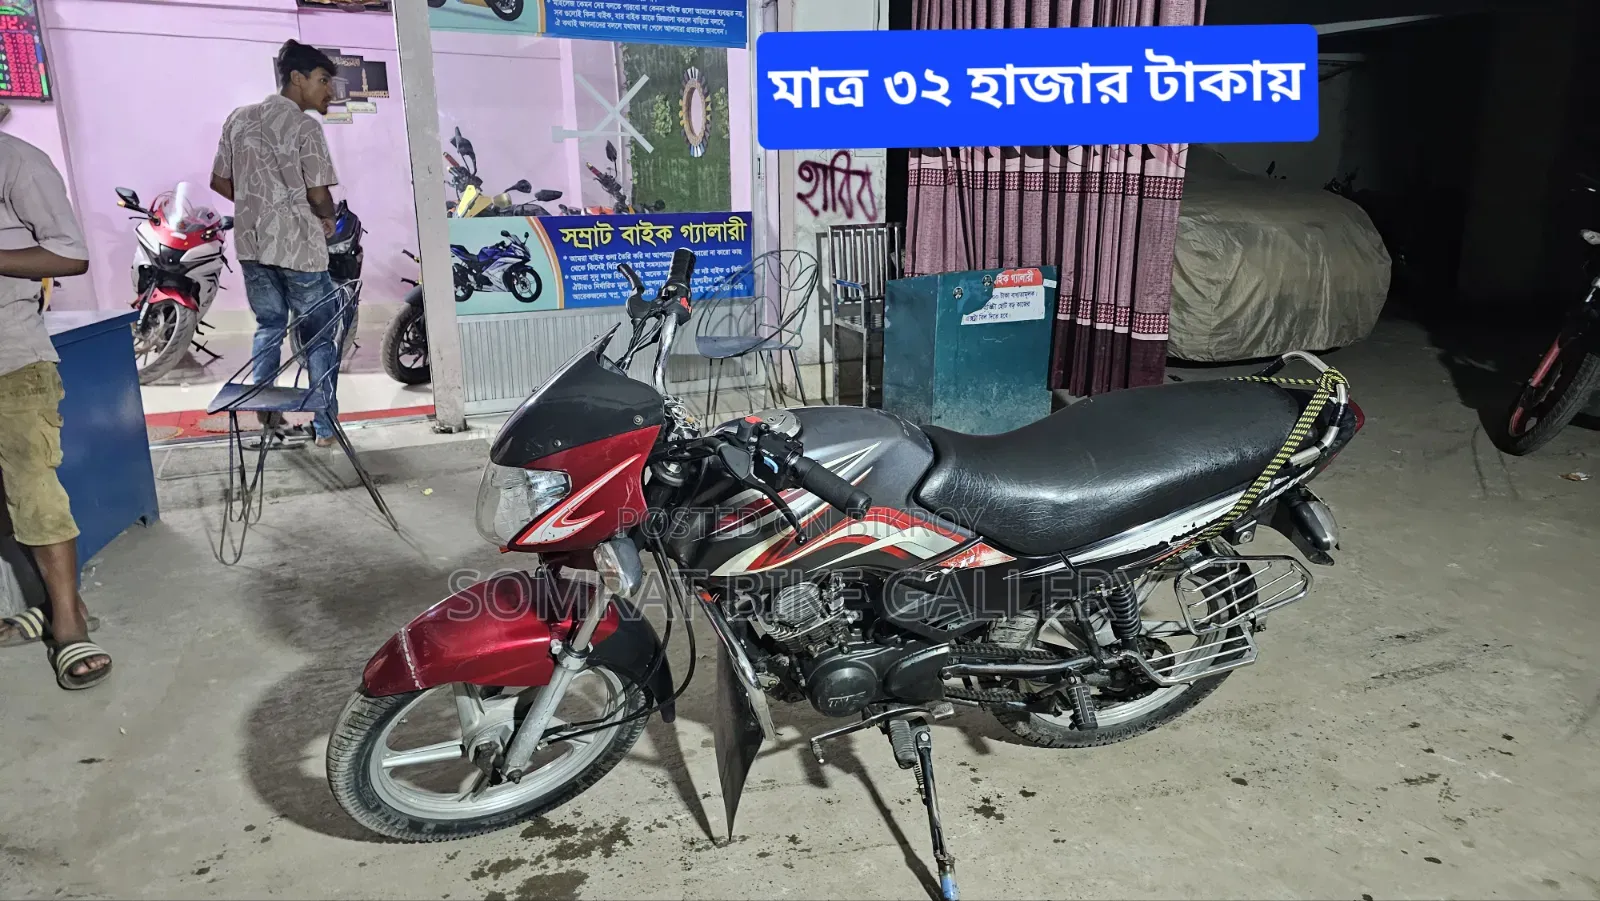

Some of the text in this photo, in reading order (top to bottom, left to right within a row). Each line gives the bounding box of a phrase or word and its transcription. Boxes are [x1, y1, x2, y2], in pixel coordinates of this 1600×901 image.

[558, 215, 748, 250] সম্রাট বাইক গ্যালারী
